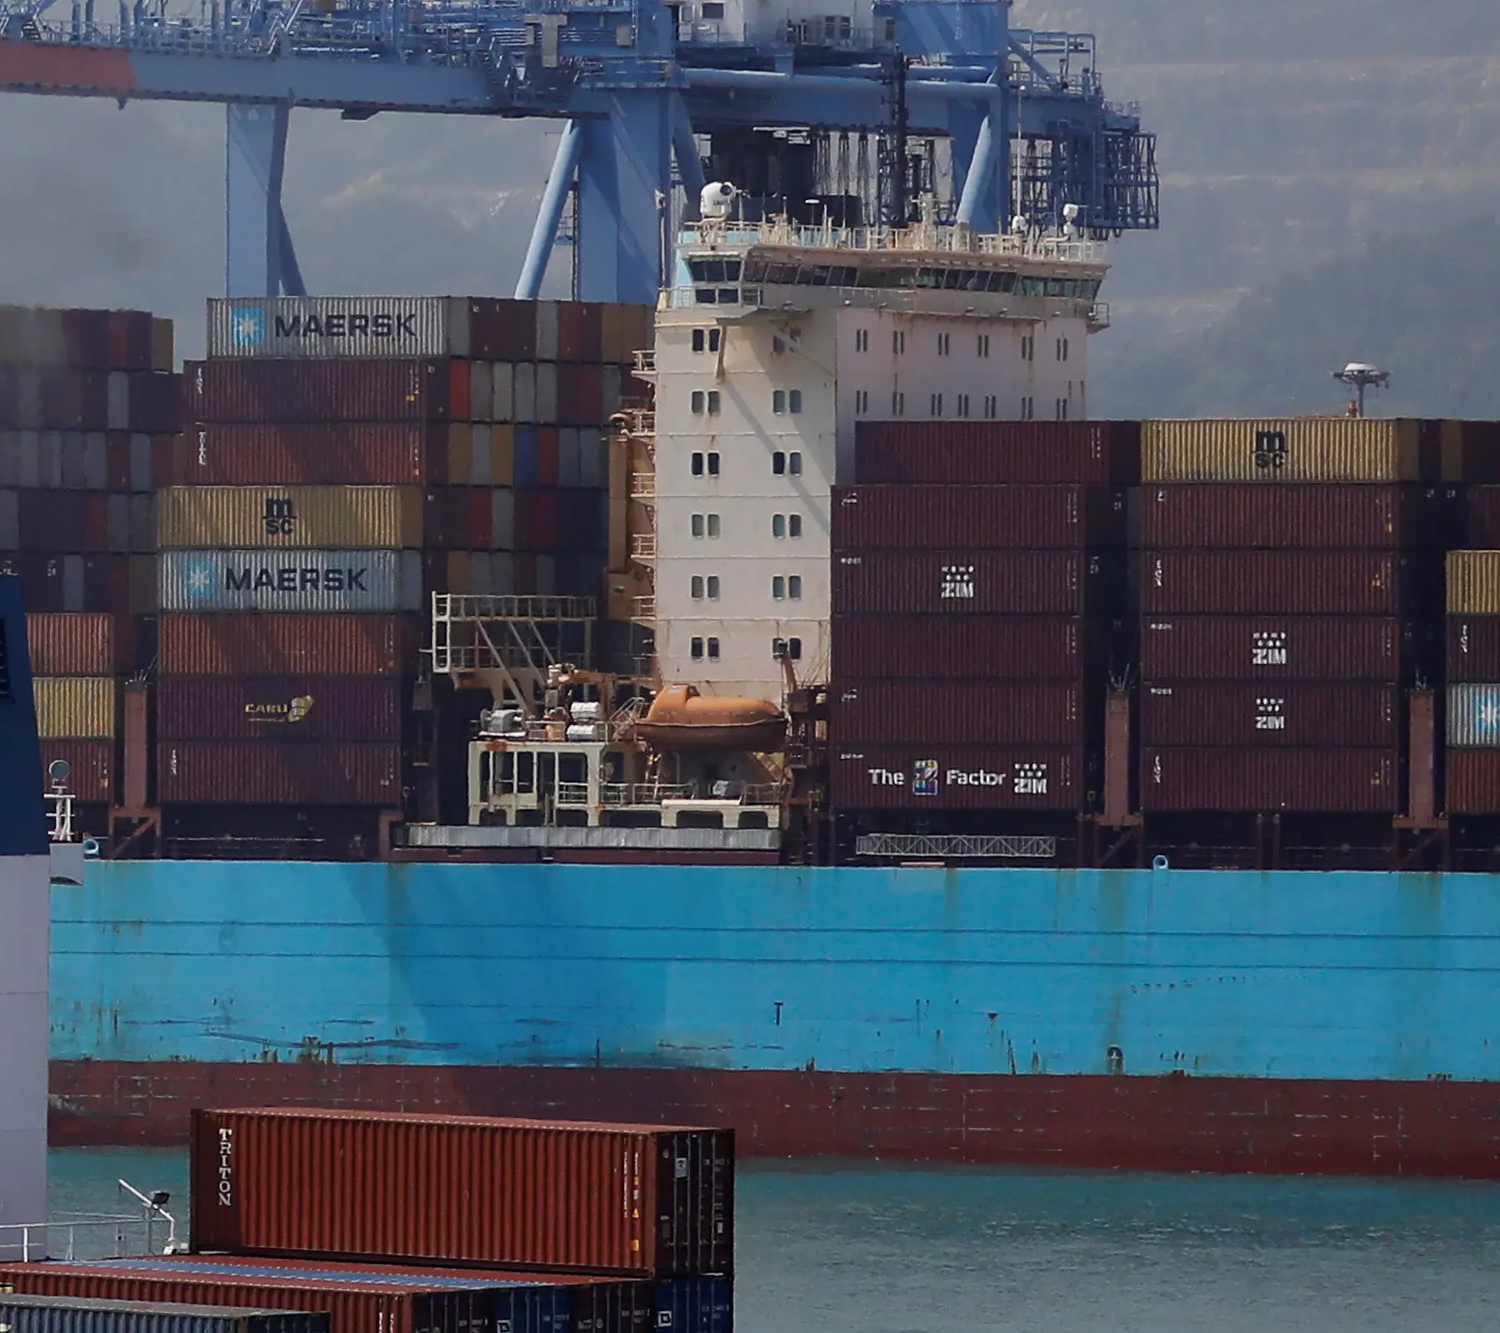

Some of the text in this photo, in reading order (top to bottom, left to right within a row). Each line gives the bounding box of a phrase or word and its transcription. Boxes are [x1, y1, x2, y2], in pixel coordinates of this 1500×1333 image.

[275, 314, 417, 338] MAERSK
[225, 568, 368, 592] MAERSK
[941, 582, 974, 598] ZIM
[1252, 647, 1287, 665] ZIM
[868, 769, 1006, 786] The Factor
[1014, 777, 1048, 794] ZIM
[219, 1128, 232, 1206] TRITON
